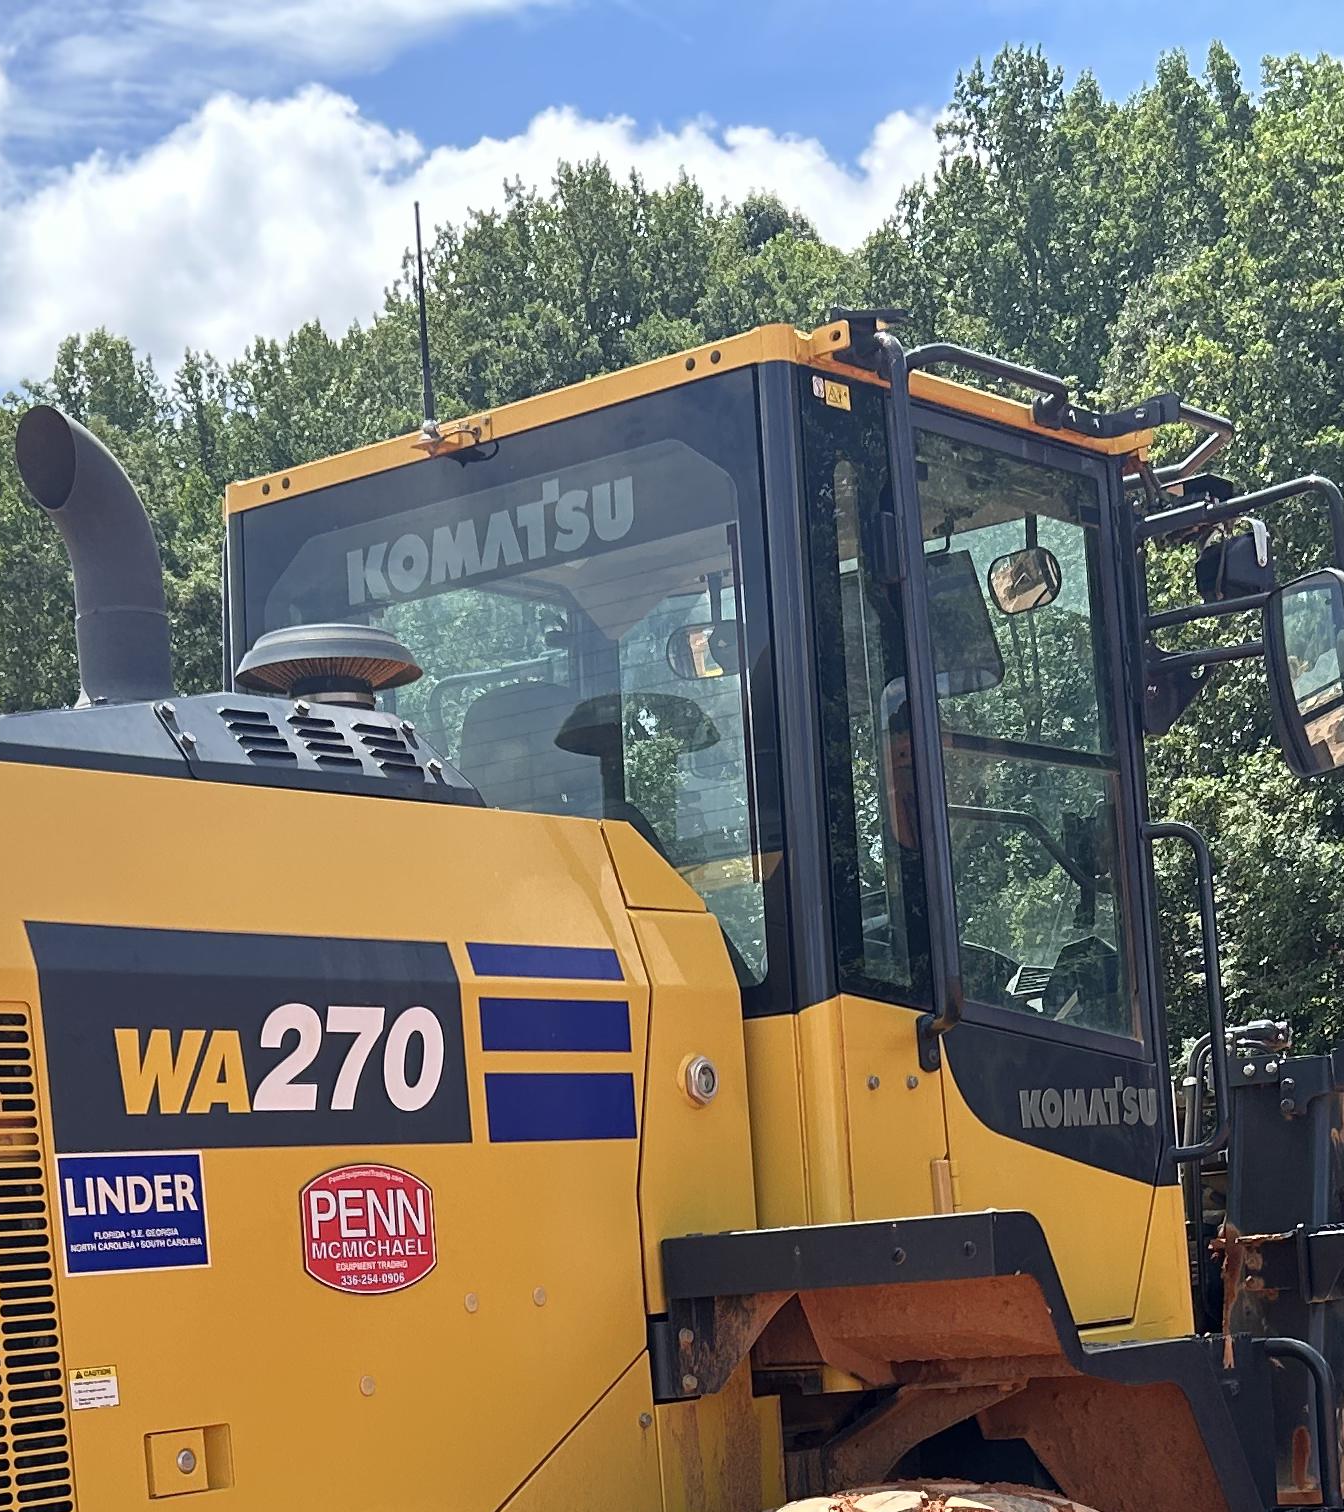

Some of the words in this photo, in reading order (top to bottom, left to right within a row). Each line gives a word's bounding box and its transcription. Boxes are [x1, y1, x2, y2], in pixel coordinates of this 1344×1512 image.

[346, 476, 634, 605] KOMATSU
[114, 1003, 445, 1115] WA270
[1018, 1076, 1157, 1128] KOMATSU
[64, 1174, 199, 1217] LINDER
[309, 1188, 426, 1239] PENN
[311, 1239, 429, 1260] MCMICHAEL
[340, 1272, 405, 1286] 336-254-0906
